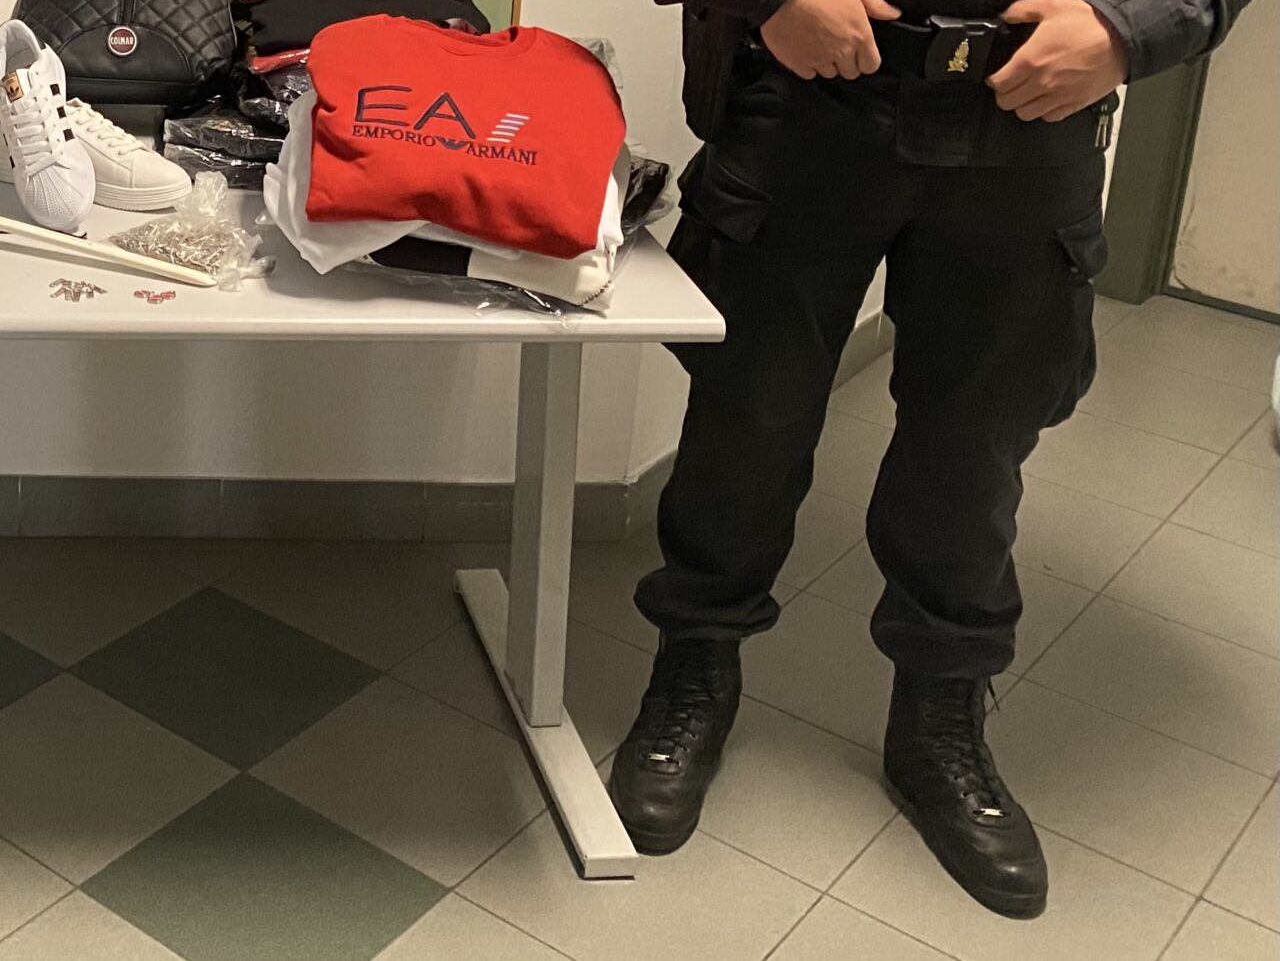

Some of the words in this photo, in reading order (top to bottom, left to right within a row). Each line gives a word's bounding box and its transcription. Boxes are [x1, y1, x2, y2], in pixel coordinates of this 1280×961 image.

[110, 36, 134, 45] COLMAR
[352, 124, 437, 148] EMPORIO
[464, 141, 538, 167] ARMANI
